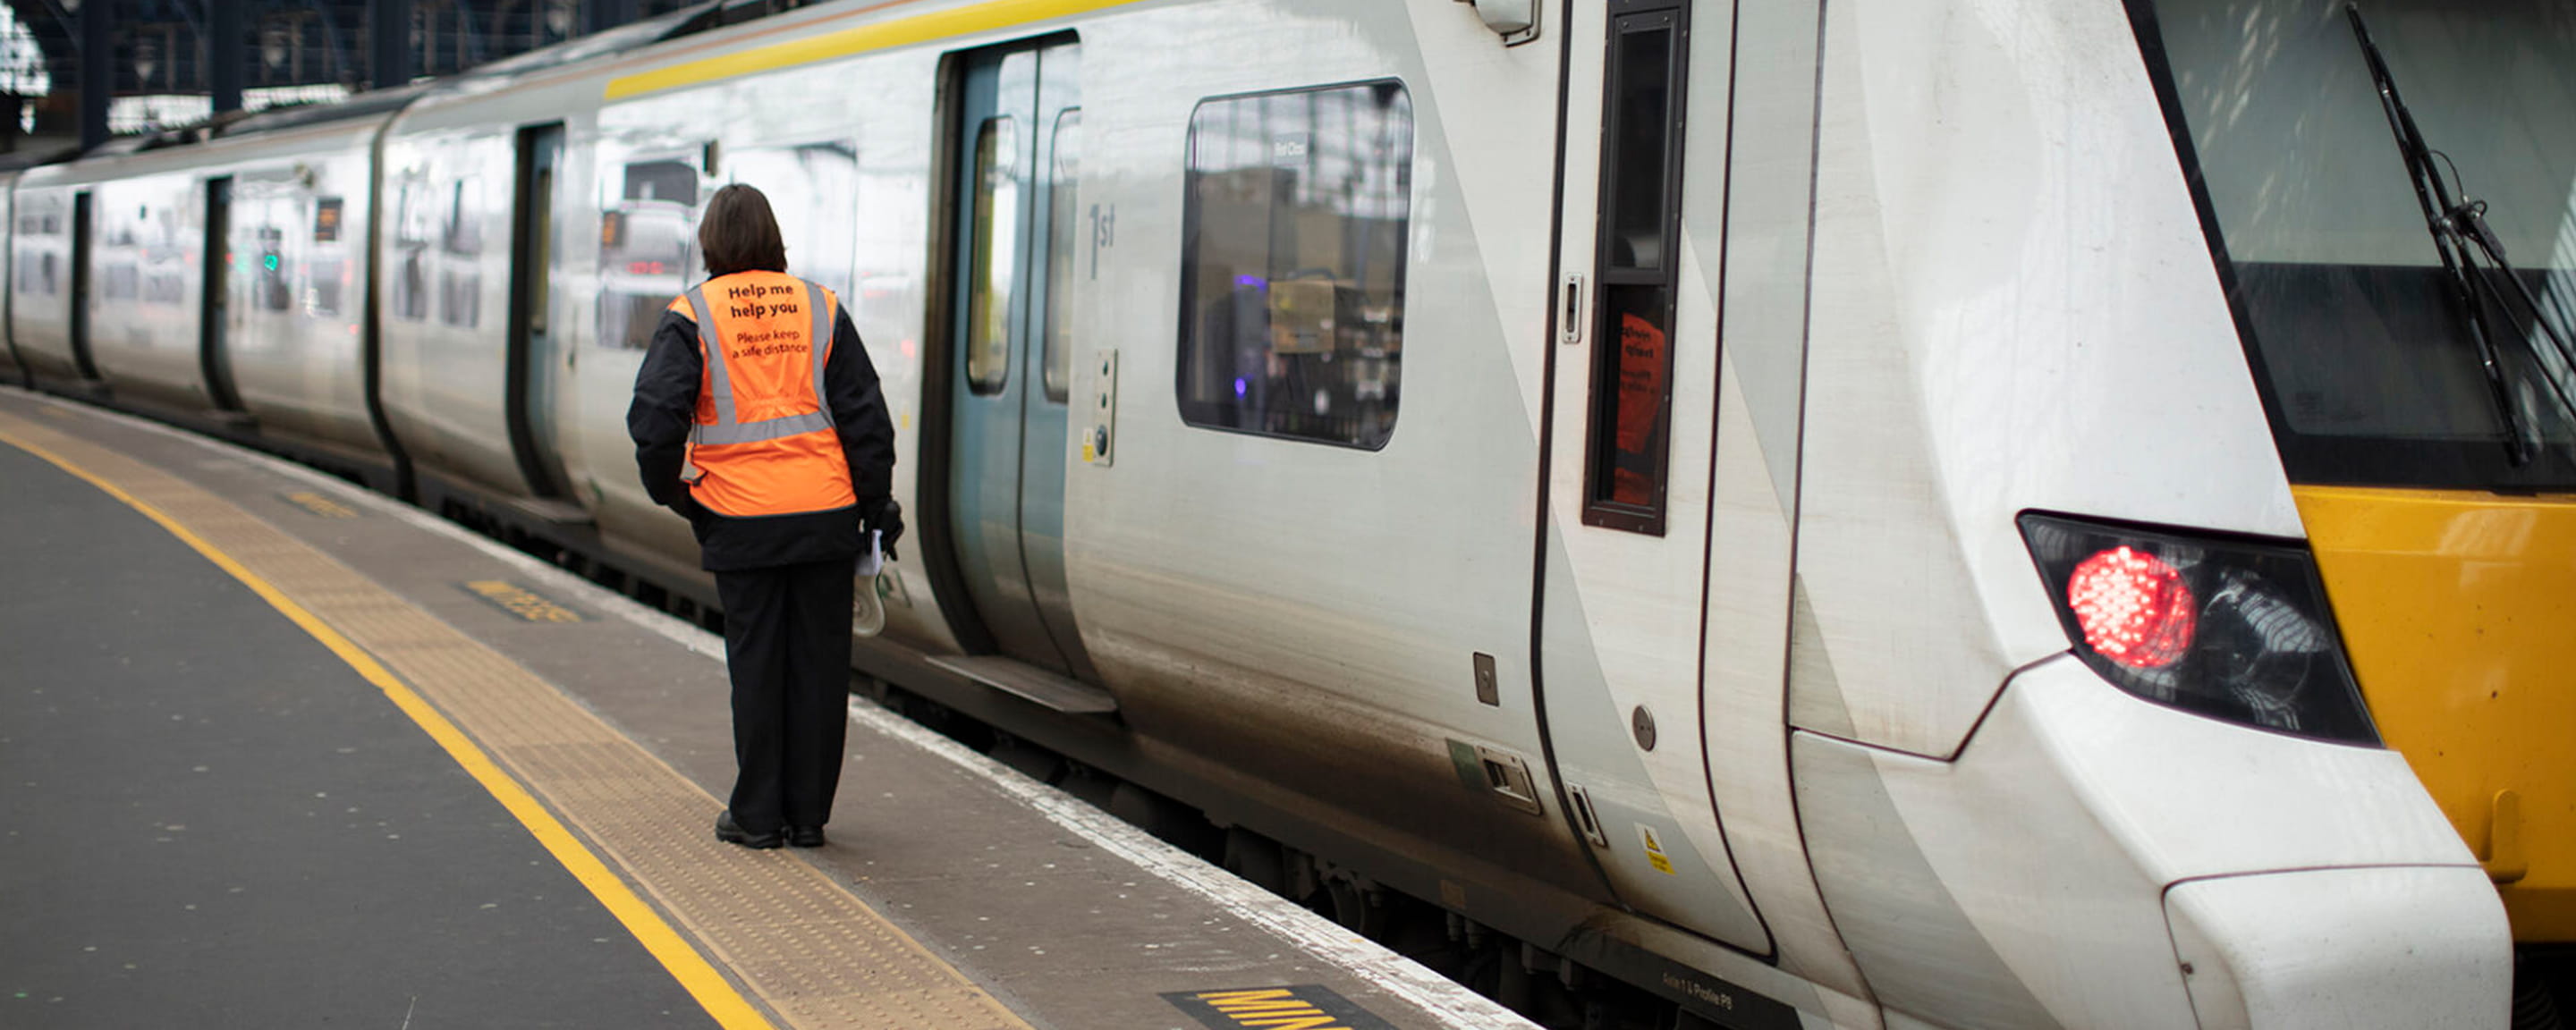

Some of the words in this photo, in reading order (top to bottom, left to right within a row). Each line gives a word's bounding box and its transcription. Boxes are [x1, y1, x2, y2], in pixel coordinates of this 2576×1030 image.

[1089, 202, 1115, 281] 1st
[729, 283, 767, 300] Help
[770, 285, 793, 295] me
[730, 302, 766, 319] help
[769, 303, 798, 317] you
[736, 332, 771, 343] Please
[773, 329, 801, 341] keep
[732, 350, 740, 359] a
[741, 345, 762, 357] safe
[764, 343, 808, 355] distance
